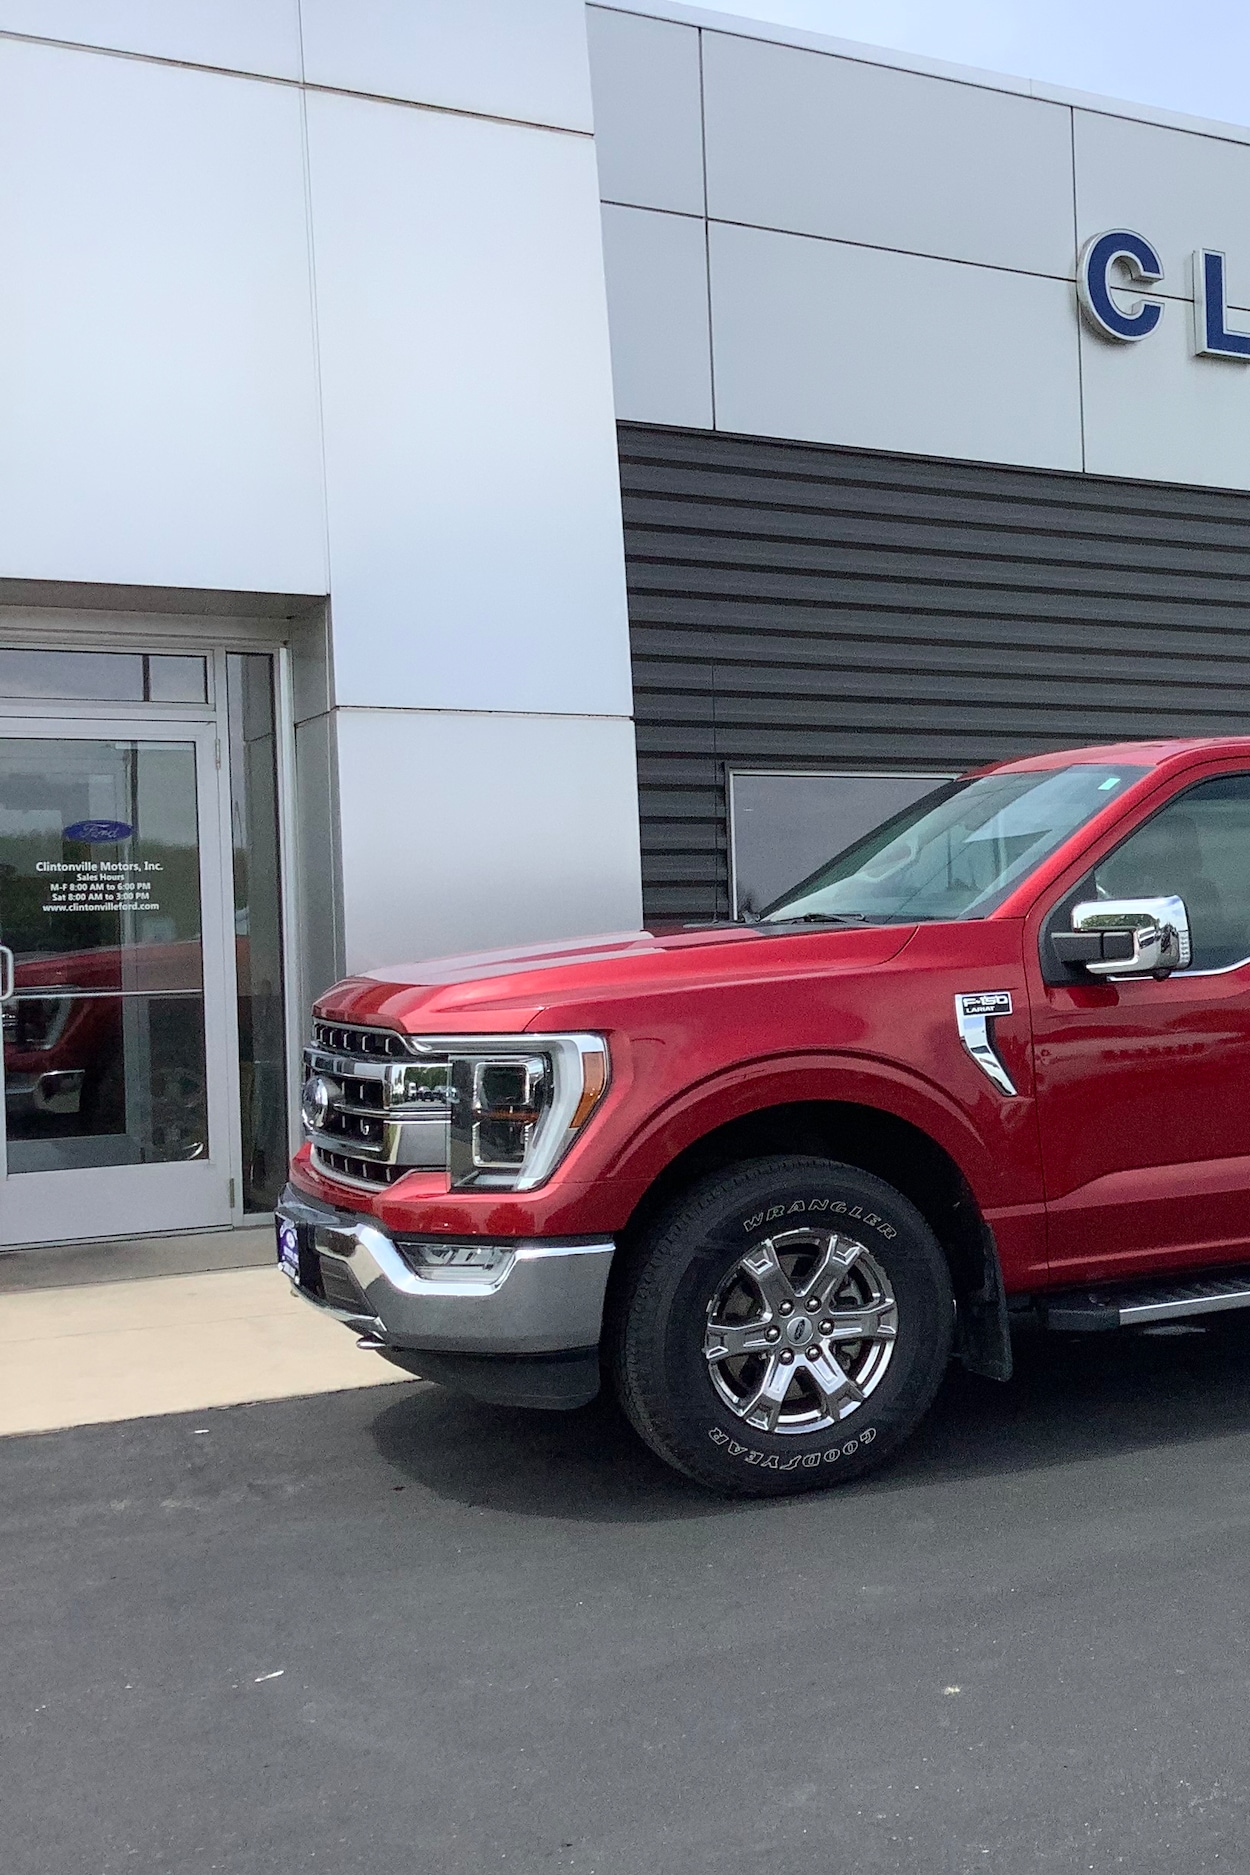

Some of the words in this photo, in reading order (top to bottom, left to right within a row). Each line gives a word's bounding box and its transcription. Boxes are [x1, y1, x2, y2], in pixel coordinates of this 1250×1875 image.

[81, 823, 120, 838] Ford
[36, 861, 98, 872] Clintonville
[100, 861, 141, 872] Motors,
[144, 861, 163, 871] Inc.
[76, 873, 98, 881] Sales
[99, 873, 125, 881] Hours
[50, 883, 68, 891] M-F
[69, 883, 88, 891] 8:00
[89, 883, 104, 891] AM
[117, 882, 135, 890] 6:00
[136, 882, 151, 890] PM
[52, 893, 66, 901] Sat
[68, 893, 86, 901] 8:00
[88, 893, 103, 901] AM
[115, 892, 134, 900] 3:00
[135, 892, 150, 900] PM
[42, 902, 160, 911] www.clintonvilleford.com
[963, 995, 1009, 1007] F-150
[965, 1005, 996, 1014] LARIAT
[743, 1199, 897, 1240] WRANGLER
[708, 1427, 877, 1470] GOODYEAR
